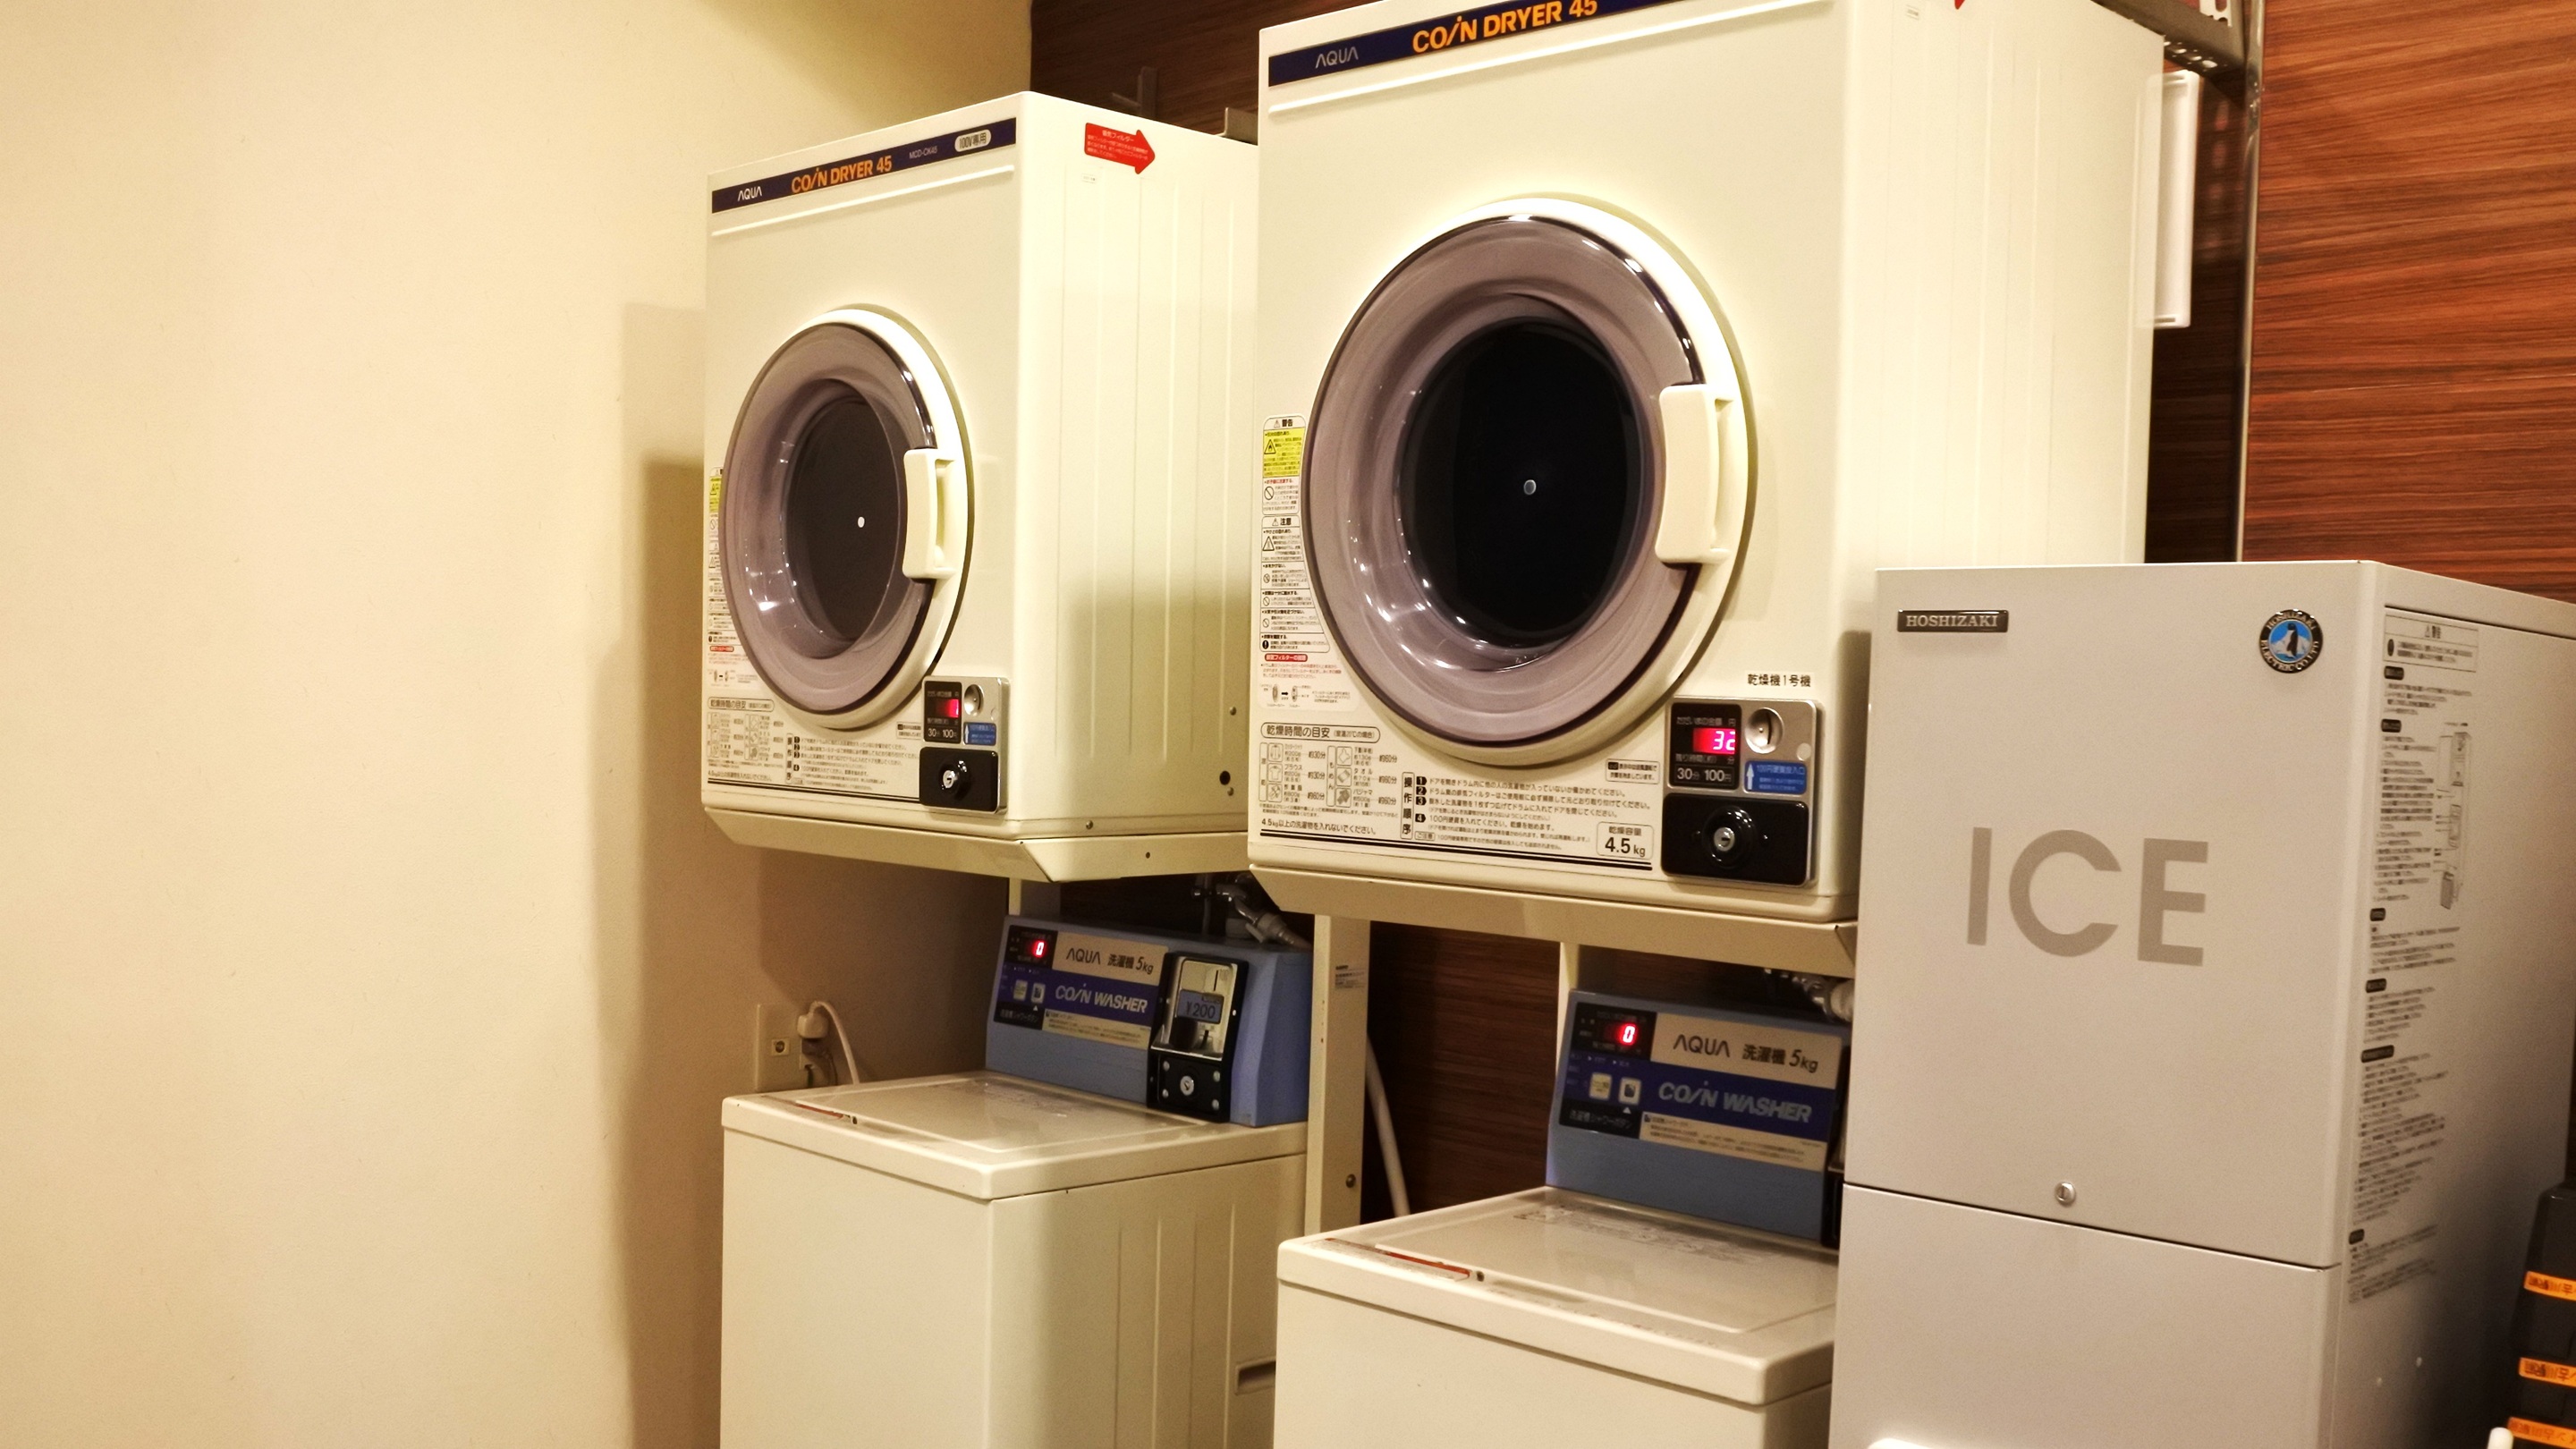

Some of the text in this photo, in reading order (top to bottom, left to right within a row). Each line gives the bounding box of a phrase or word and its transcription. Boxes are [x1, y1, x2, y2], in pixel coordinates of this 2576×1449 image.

[1412, 0, 1597, 54] COIN DRYER 45
[1315, 47, 1359, 69] AQUA
[792, 155, 892, 193] COIN DRYER 45
[737, 186, 763, 202] AQUA
[1905, 614, 1998, 627] HOSHIZAKI
[1747, 674, 1811, 688] 乾燥機1号機
[1267, 724, 1330, 739] 乾燥時間の目安
[1402, 776, 1413, 835] 操作順序
[1608, 826, 1642, 836] 乾燥容量
[1605, 836, 1646, 858] 4.5 kg
[1967, 826, 2209, 968] ICE
[1035, 941, 1045, 956] 0
[1065, 947, 1154, 975] AQUA 洗濯機 5kg
[1055, 982, 1148, 1013] COIN WASHER
[1185, 999, 1216, 1020] ¥200
[1623, 1024, 1636, 1044] 0
[1673, 1034, 1819, 1073] AQUA 洗濯機 5kg
[1658, 1080, 1813, 1123] COIN WASHER
